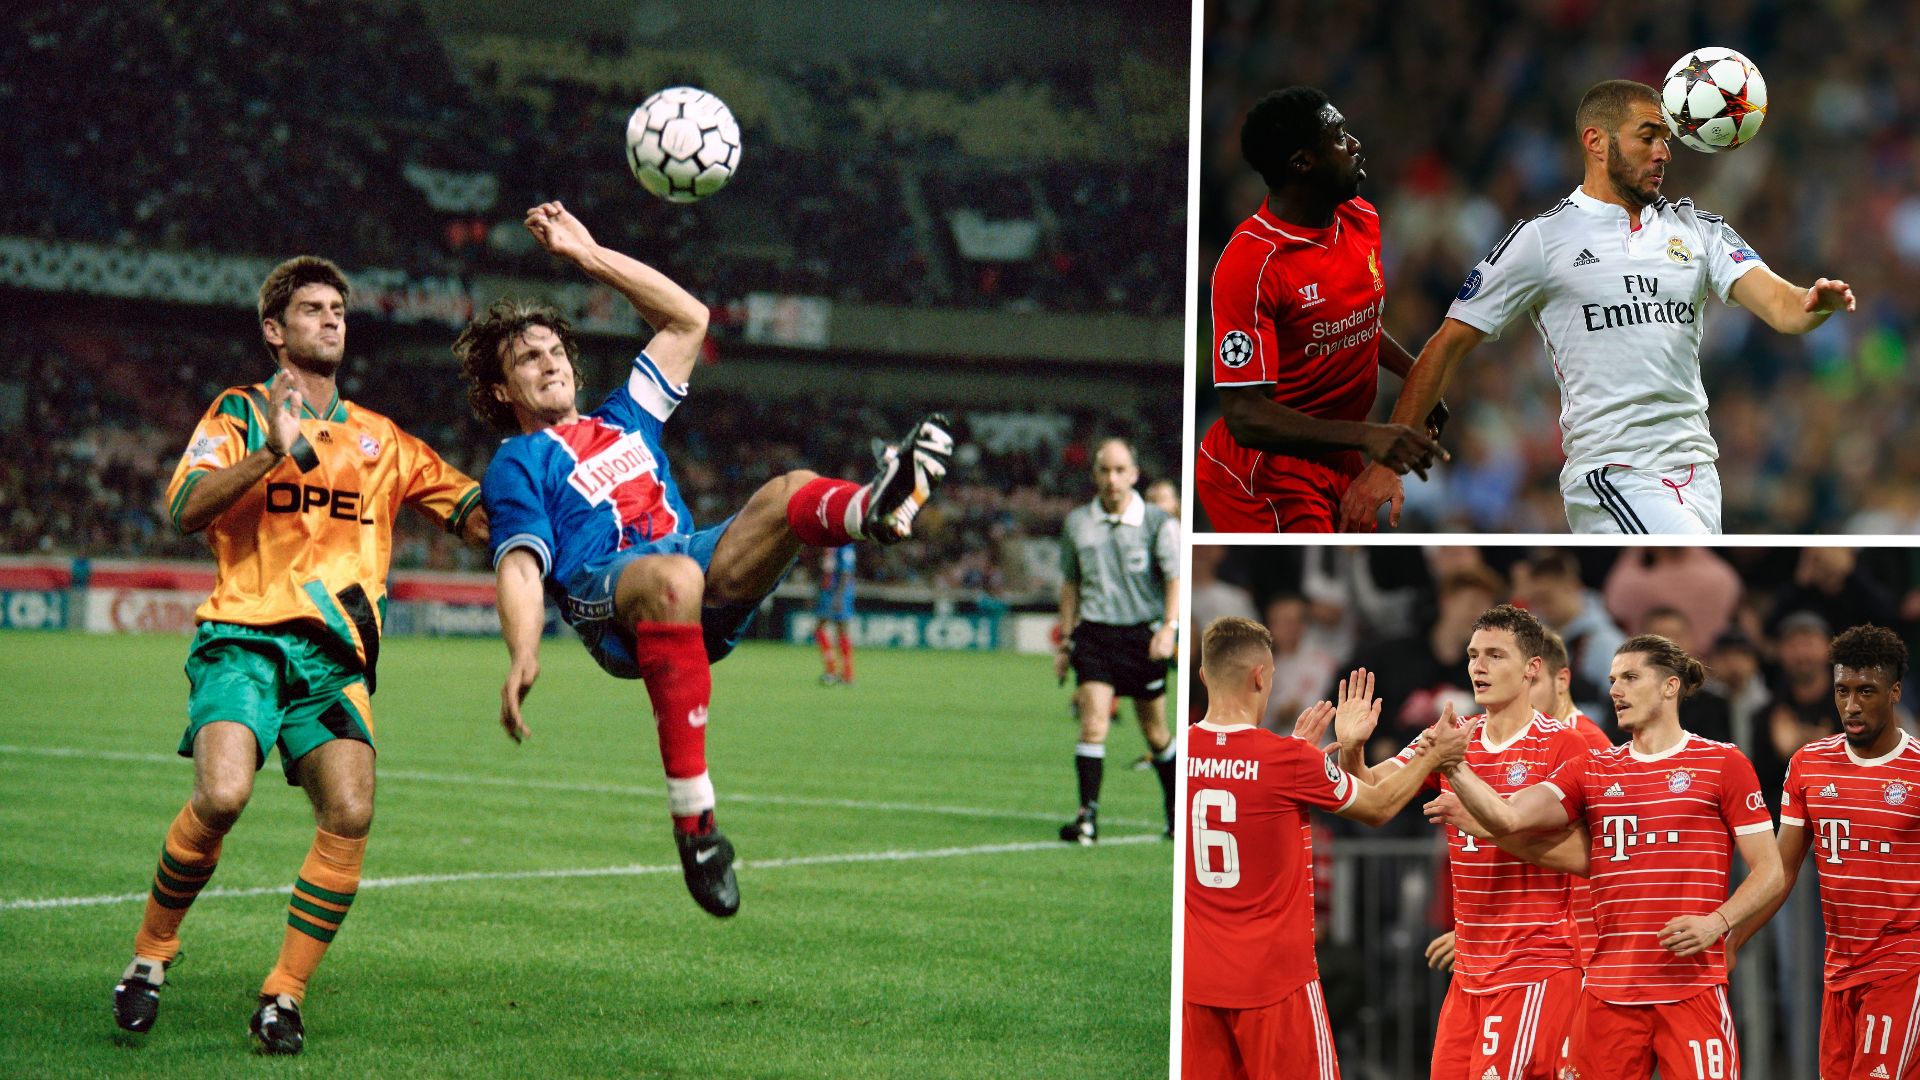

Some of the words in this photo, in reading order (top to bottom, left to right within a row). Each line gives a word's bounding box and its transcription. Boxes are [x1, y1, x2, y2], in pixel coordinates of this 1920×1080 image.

[1573, 257, 1600, 268] adidas
[1623, 275, 1658, 297] Fly
[1312, 302, 1375, 339] Standard
[1582, 295, 1695, 332] Emirates
[1304, 322, 1375, 358] Chartered
[266, 482, 374, 525] OPEL
[1187, 757, 1259, 781] IMMICH
[1192, 788, 1240, 889] 6
[1482, 1015, 1503, 1056] 5
[1863, 1014, 1893, 1055] 11
[1688, 1038, 1724, 1080] 18
